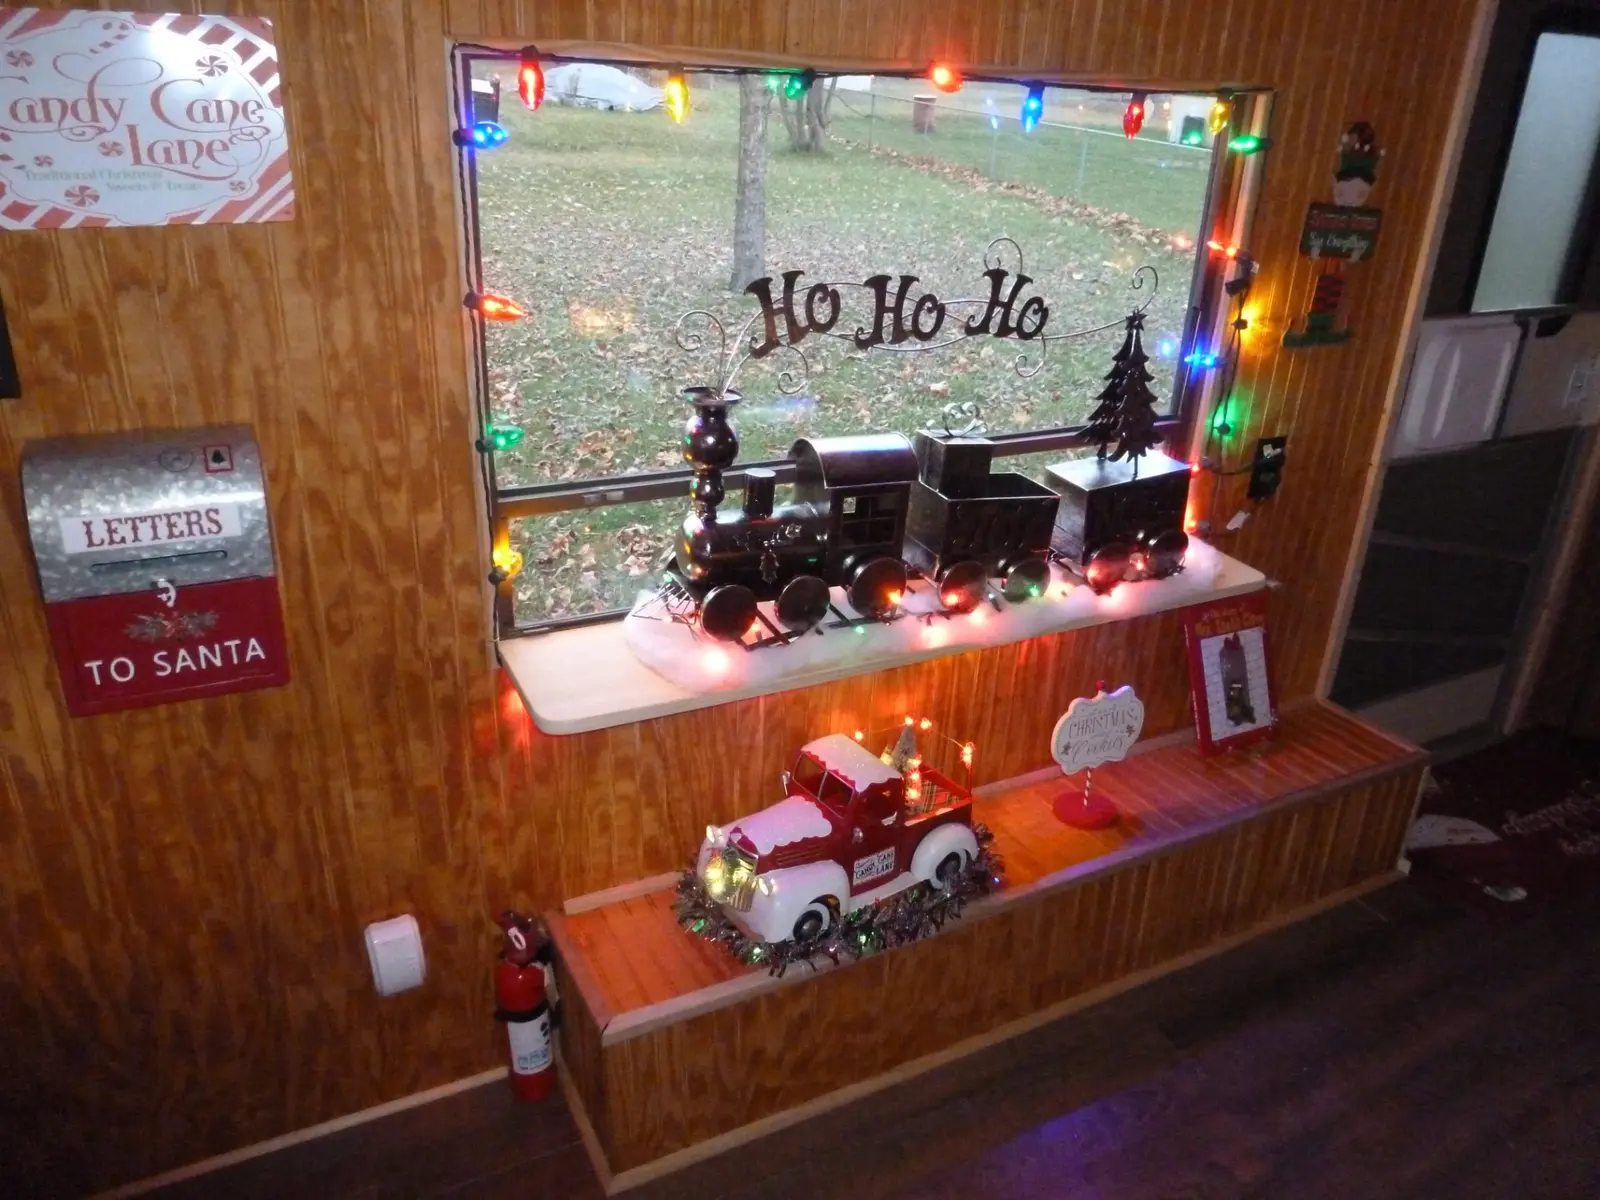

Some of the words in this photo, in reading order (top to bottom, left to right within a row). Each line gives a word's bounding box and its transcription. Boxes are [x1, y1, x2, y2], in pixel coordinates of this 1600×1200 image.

[150, 79, 270, 141] Cane
[124, 123, 246, 180] Lane
[82, 508, 223, 549] LETTERS
[85, 656, 136, 686] TO
[153, 637, 266, 677] SANTA
